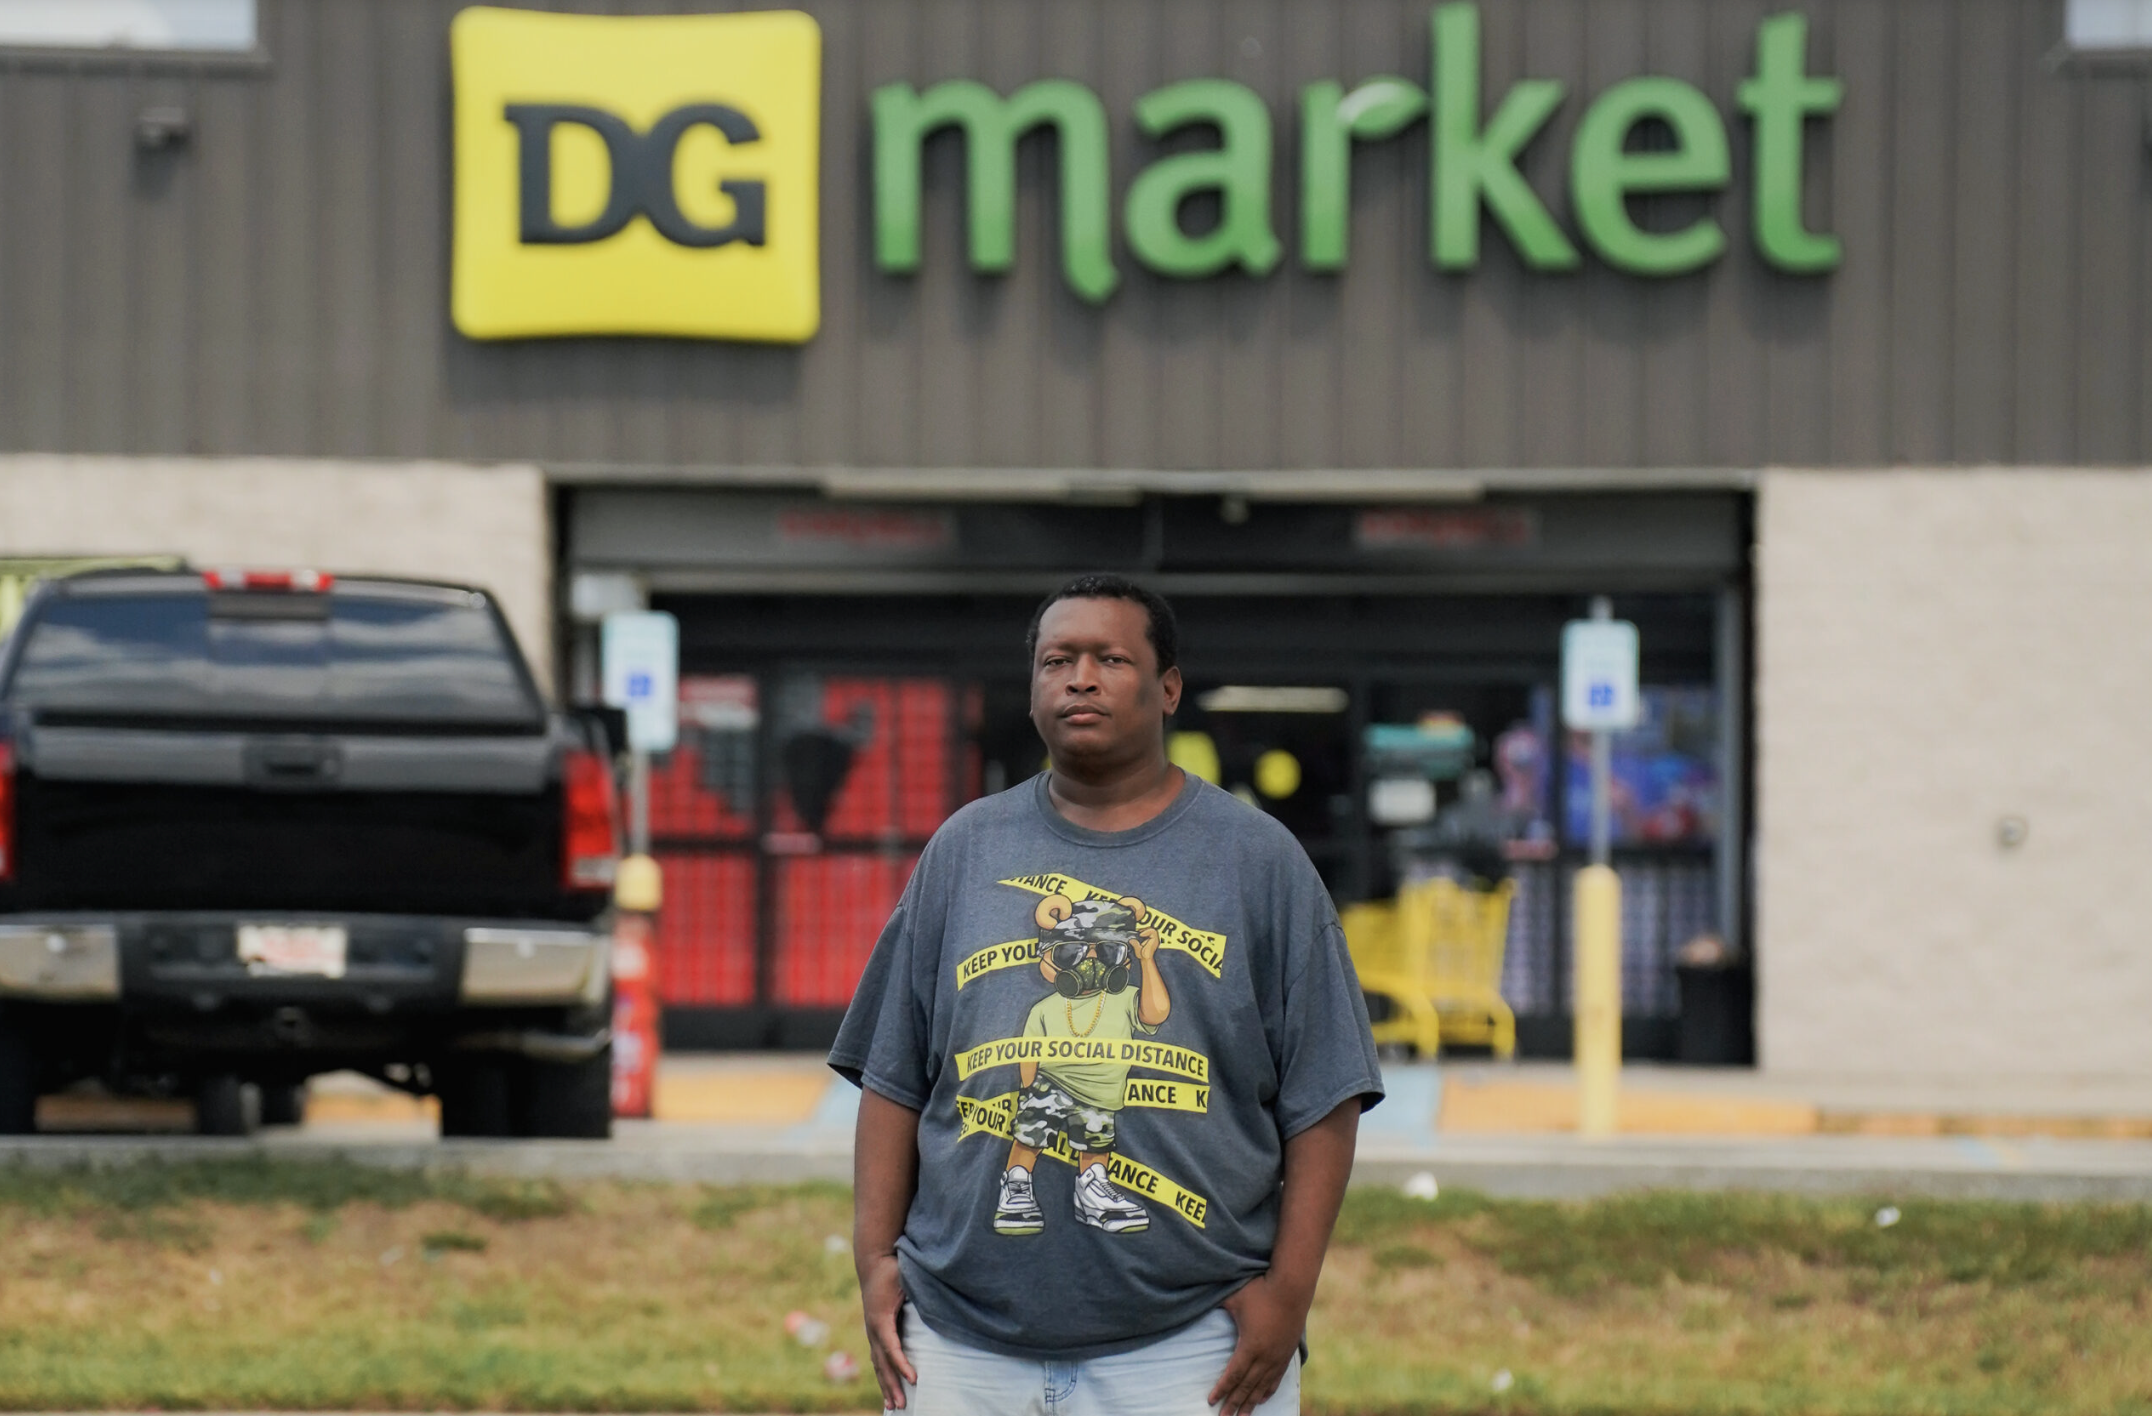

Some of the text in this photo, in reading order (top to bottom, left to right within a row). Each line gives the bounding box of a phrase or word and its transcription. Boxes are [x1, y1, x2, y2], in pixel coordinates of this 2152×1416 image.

[503, 2, 1842, 300] DG market
[1010, 875, 1068, 895] ANCE
[963, 950, 998, 980] KEEP
[967, 1040, 1204, 1077] KEEP YOUR SOCIAL DISTANCE
[1128, 1083, 1207, 1108] ANCE K
[1108, 1157, 1160, 1195] ANCE
[1175, 1190, 1206, 1222] KEE
